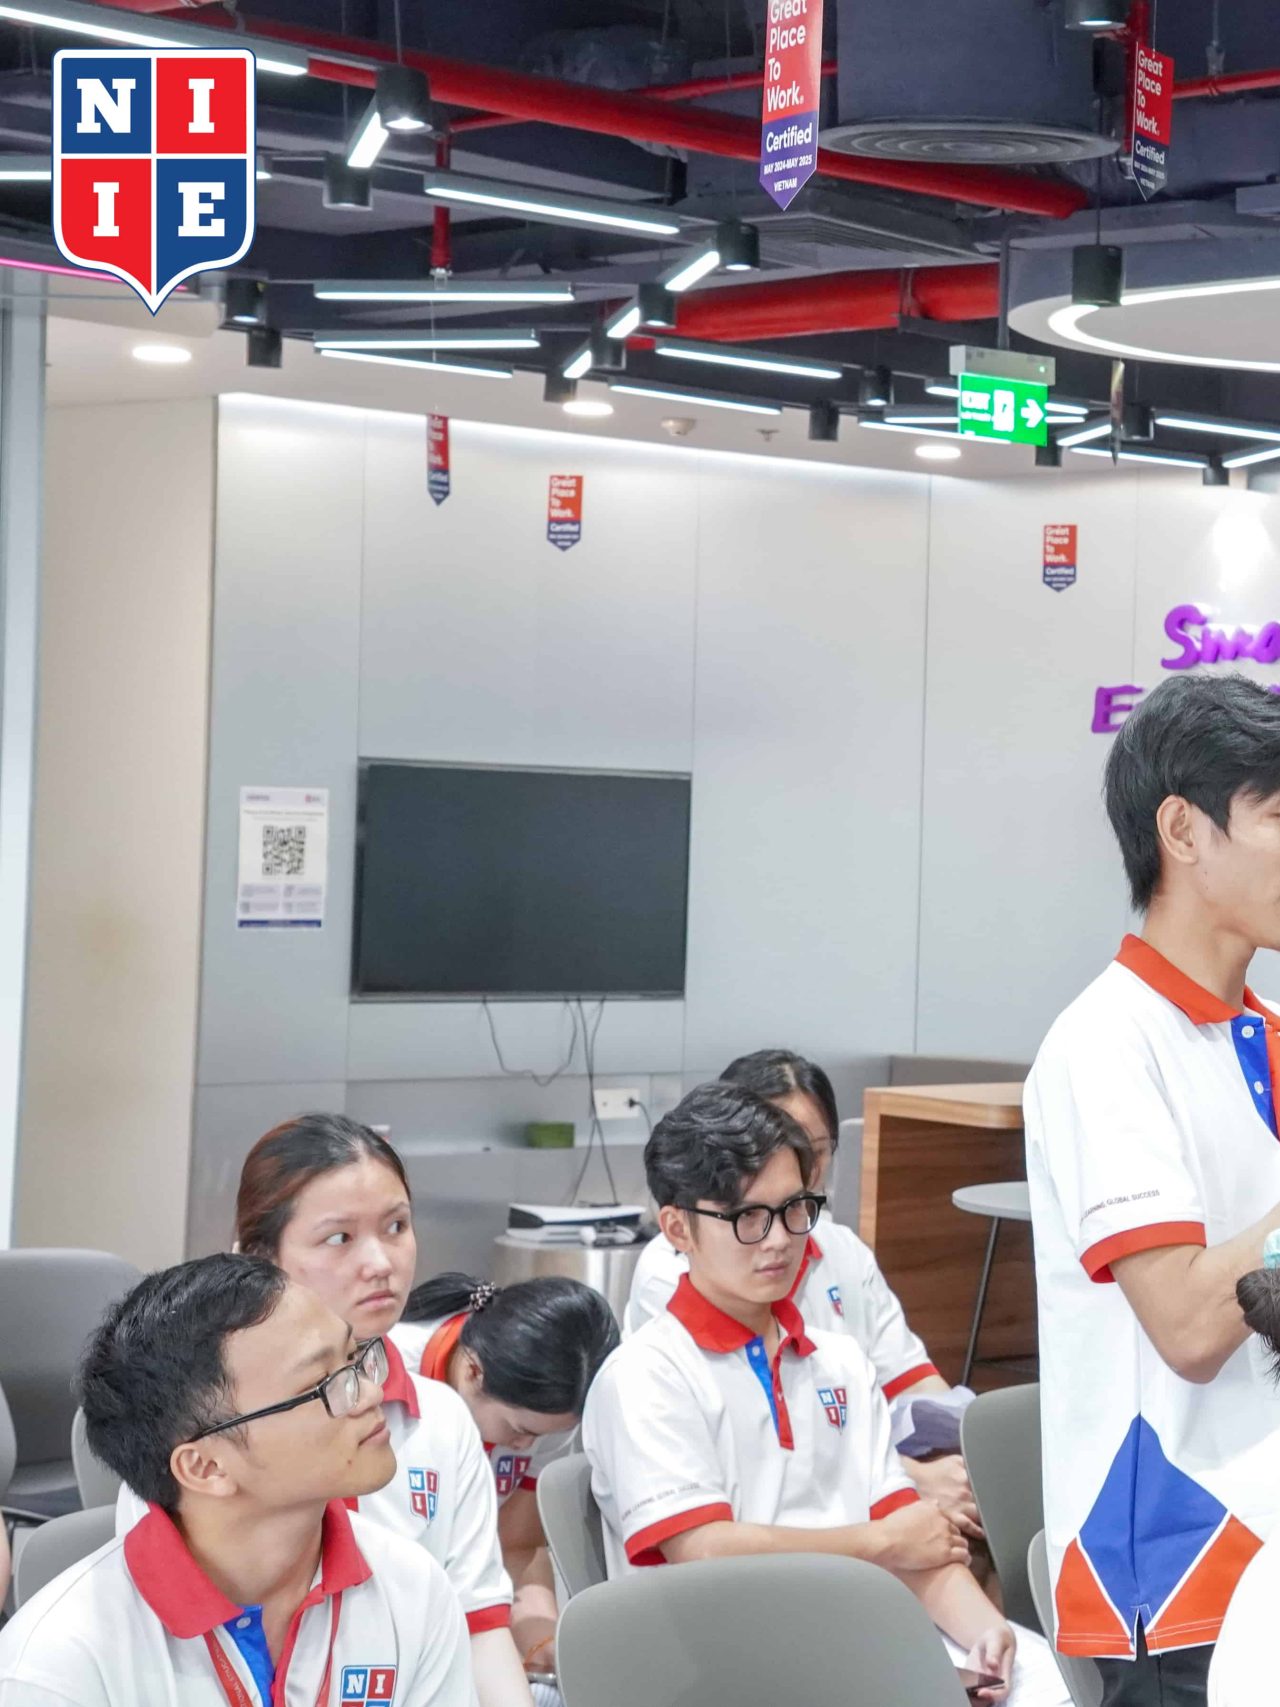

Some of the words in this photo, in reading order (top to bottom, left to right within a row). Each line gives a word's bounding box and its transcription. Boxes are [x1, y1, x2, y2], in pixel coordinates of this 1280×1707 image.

[769, 25, 806, 53] Place
[768, 57, 781, 82] To
[1138, 49, 1163, 77] Great
[1138, 69, 1162, 96] Place
[1137, 89, 1146, 108] To
[766, 122, 812, 153] Certified
[1135, 140, 1165, 165] Certified
[774, 177, 798, 192] VIETNAM
[1131, 1188, 1160, 1201] SUCCESS
